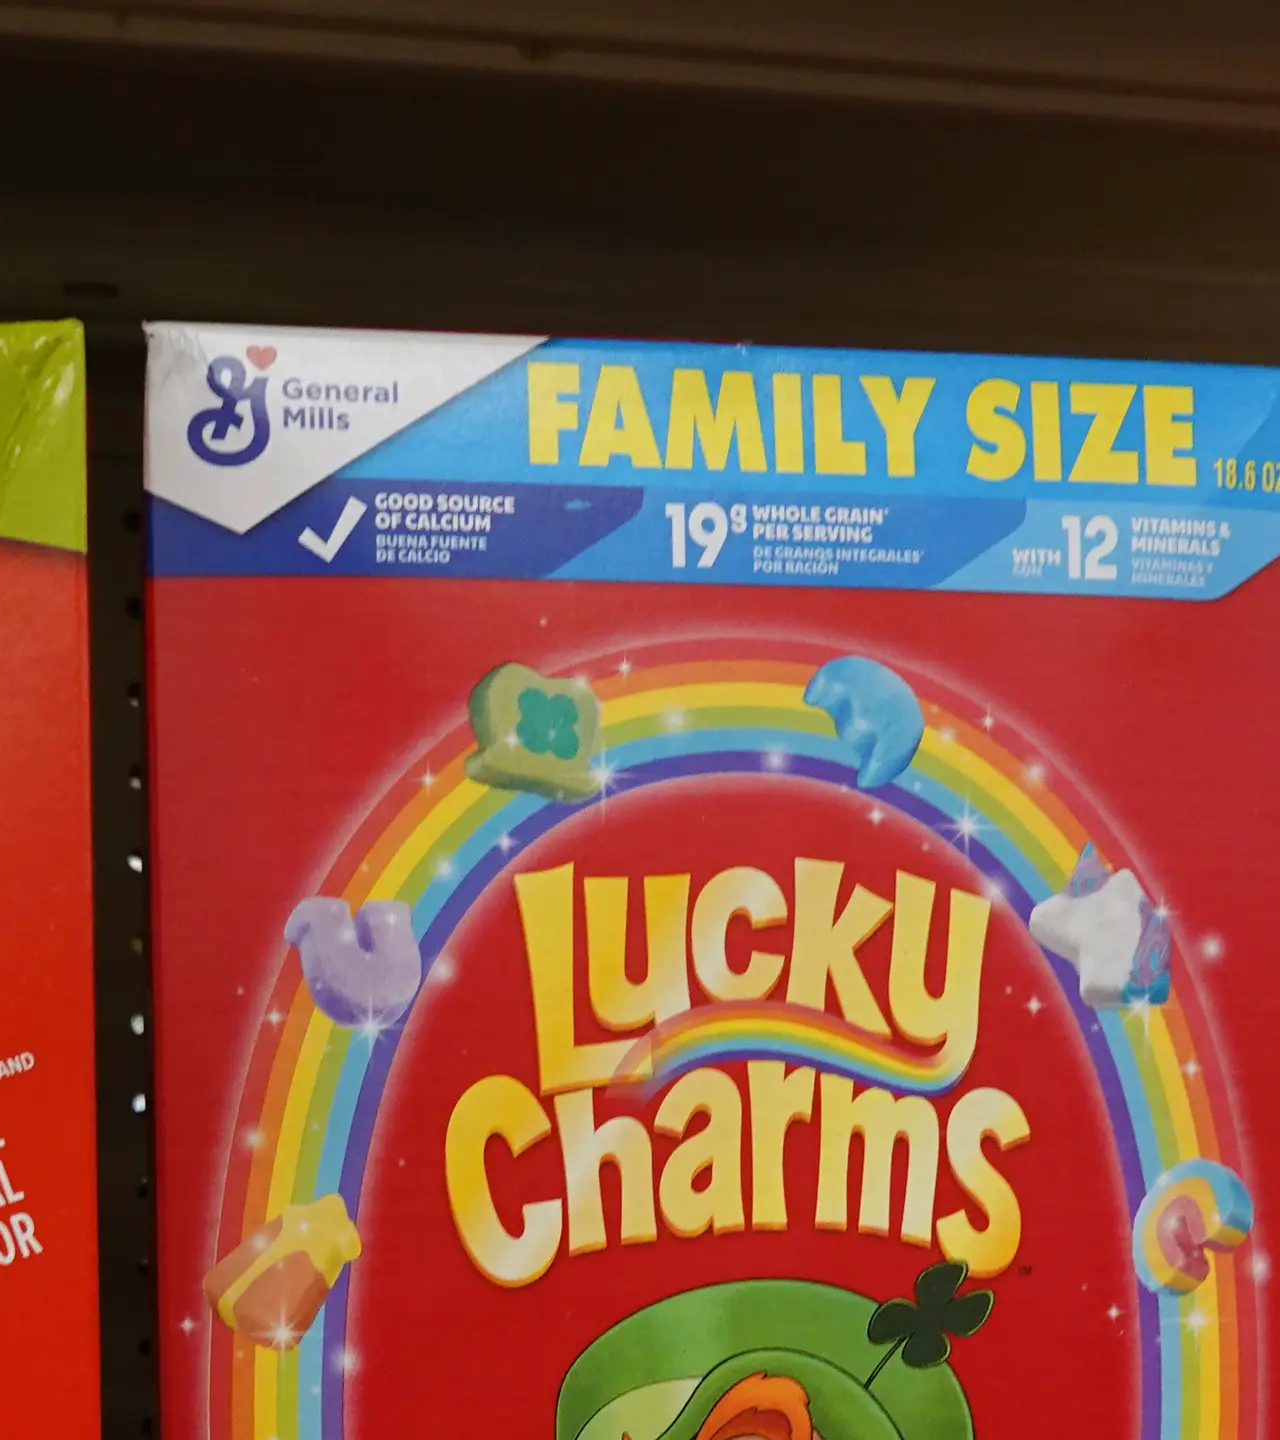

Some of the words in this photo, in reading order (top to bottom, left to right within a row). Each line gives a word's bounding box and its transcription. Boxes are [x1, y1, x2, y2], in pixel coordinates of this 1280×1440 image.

[282, 378, 399, 403] General
[282, 407, 350, 432] Mills
[527, 361, 936, 478] FAMILY
[965, 379, 1196, 487] SIZE
[1214, 457, 1255, 489] 18.6
[374, 493, 433, 511] GOOD
[436, 494, 515, 515] SOURCE
[375, 513, 401, 530] OF
[405, 513, 491, 532] CALCIUM
[1061, 515, 1118, 580] 12
[445, 1060, 1030, 1288] Charms
